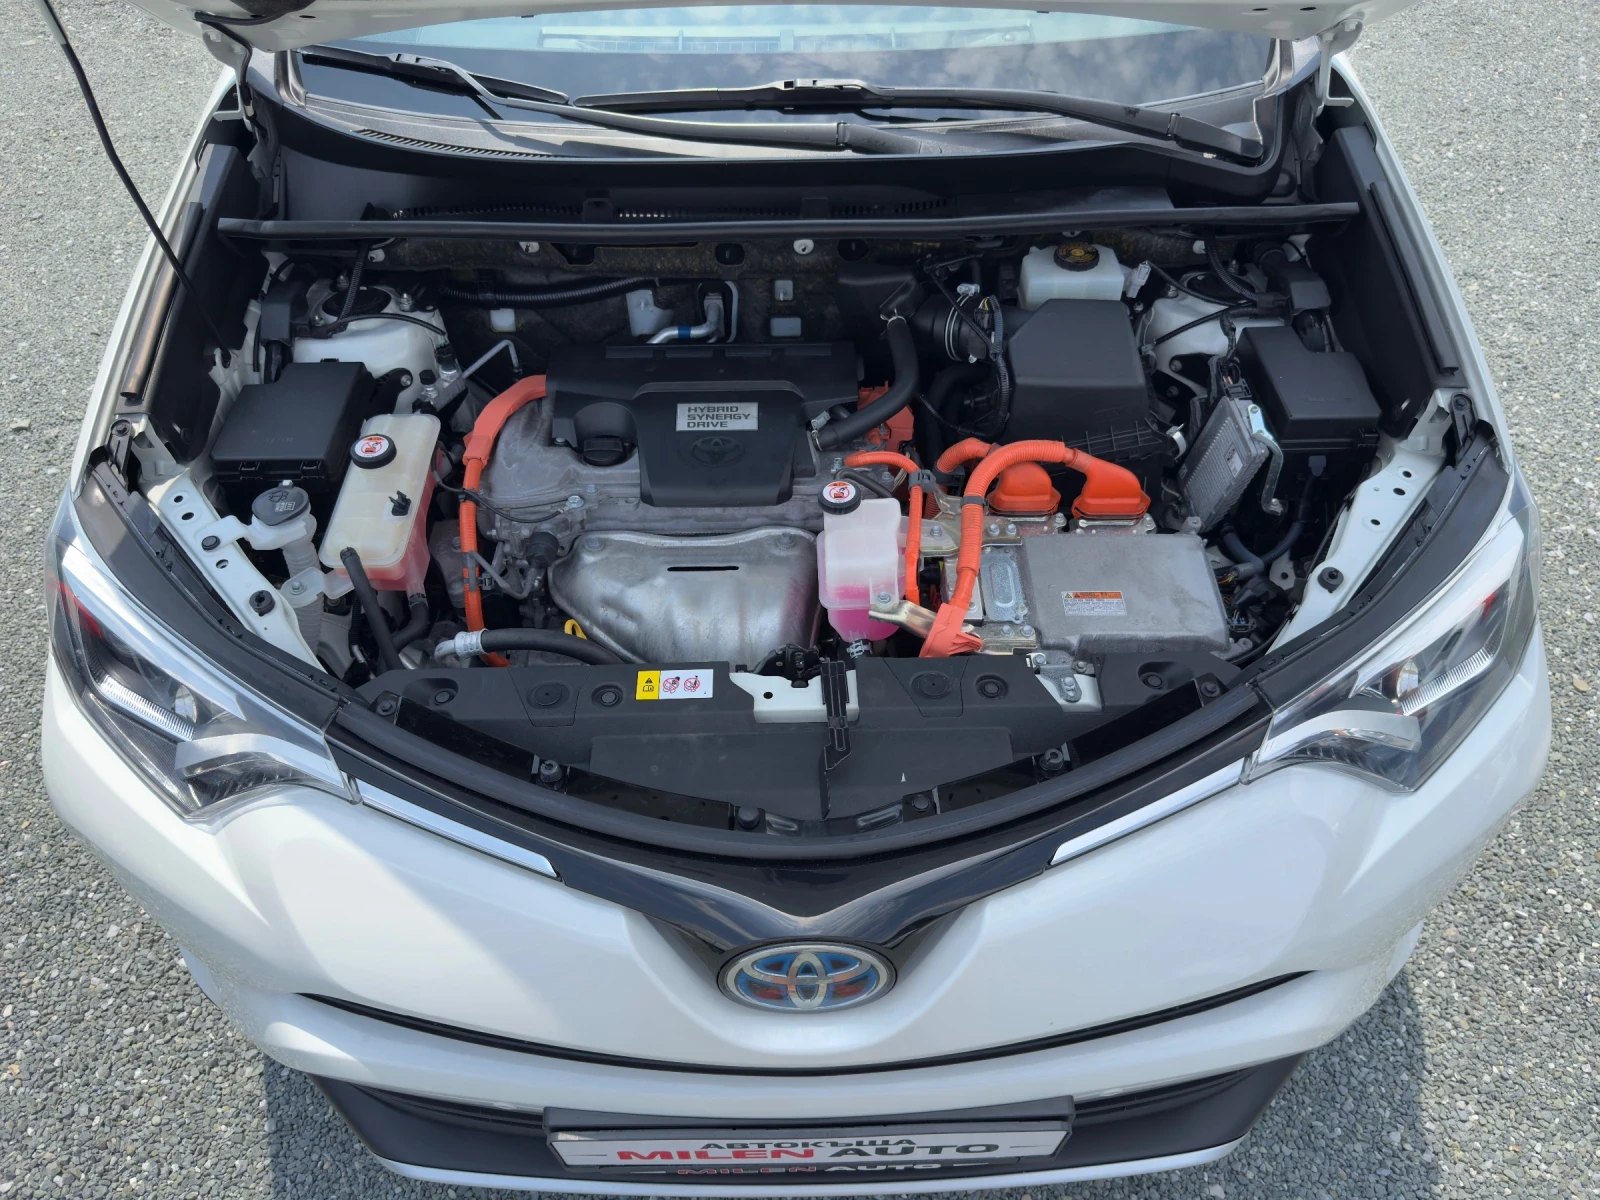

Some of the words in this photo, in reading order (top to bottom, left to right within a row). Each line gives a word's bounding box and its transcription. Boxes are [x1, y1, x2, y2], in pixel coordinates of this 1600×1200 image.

[687, 413, 751, 421] SYNERGY
[617, 1149, 815, 1160] MILEN
[828, 1143, 1000, 1158] AUTO
[824, 1163, 942, 1172] AUTO
